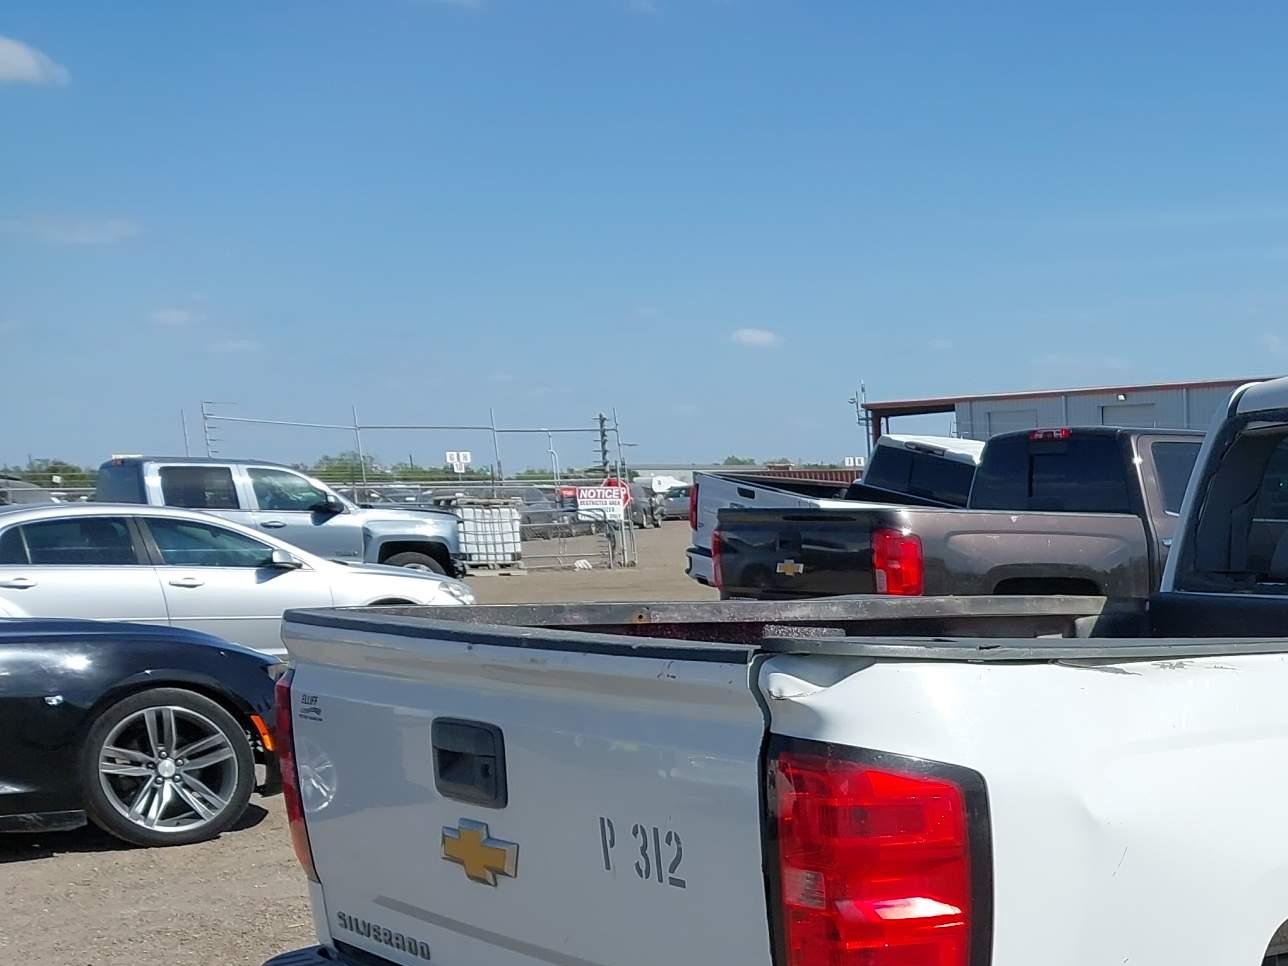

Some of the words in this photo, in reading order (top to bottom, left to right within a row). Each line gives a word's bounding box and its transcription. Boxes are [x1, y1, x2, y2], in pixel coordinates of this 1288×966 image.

[579, 488, 620, 499] NOTICE
[599, 816, 616, 871] P
[631, 823, 687, 889] 312
[336, 910, 432, 961] SILVERADO
